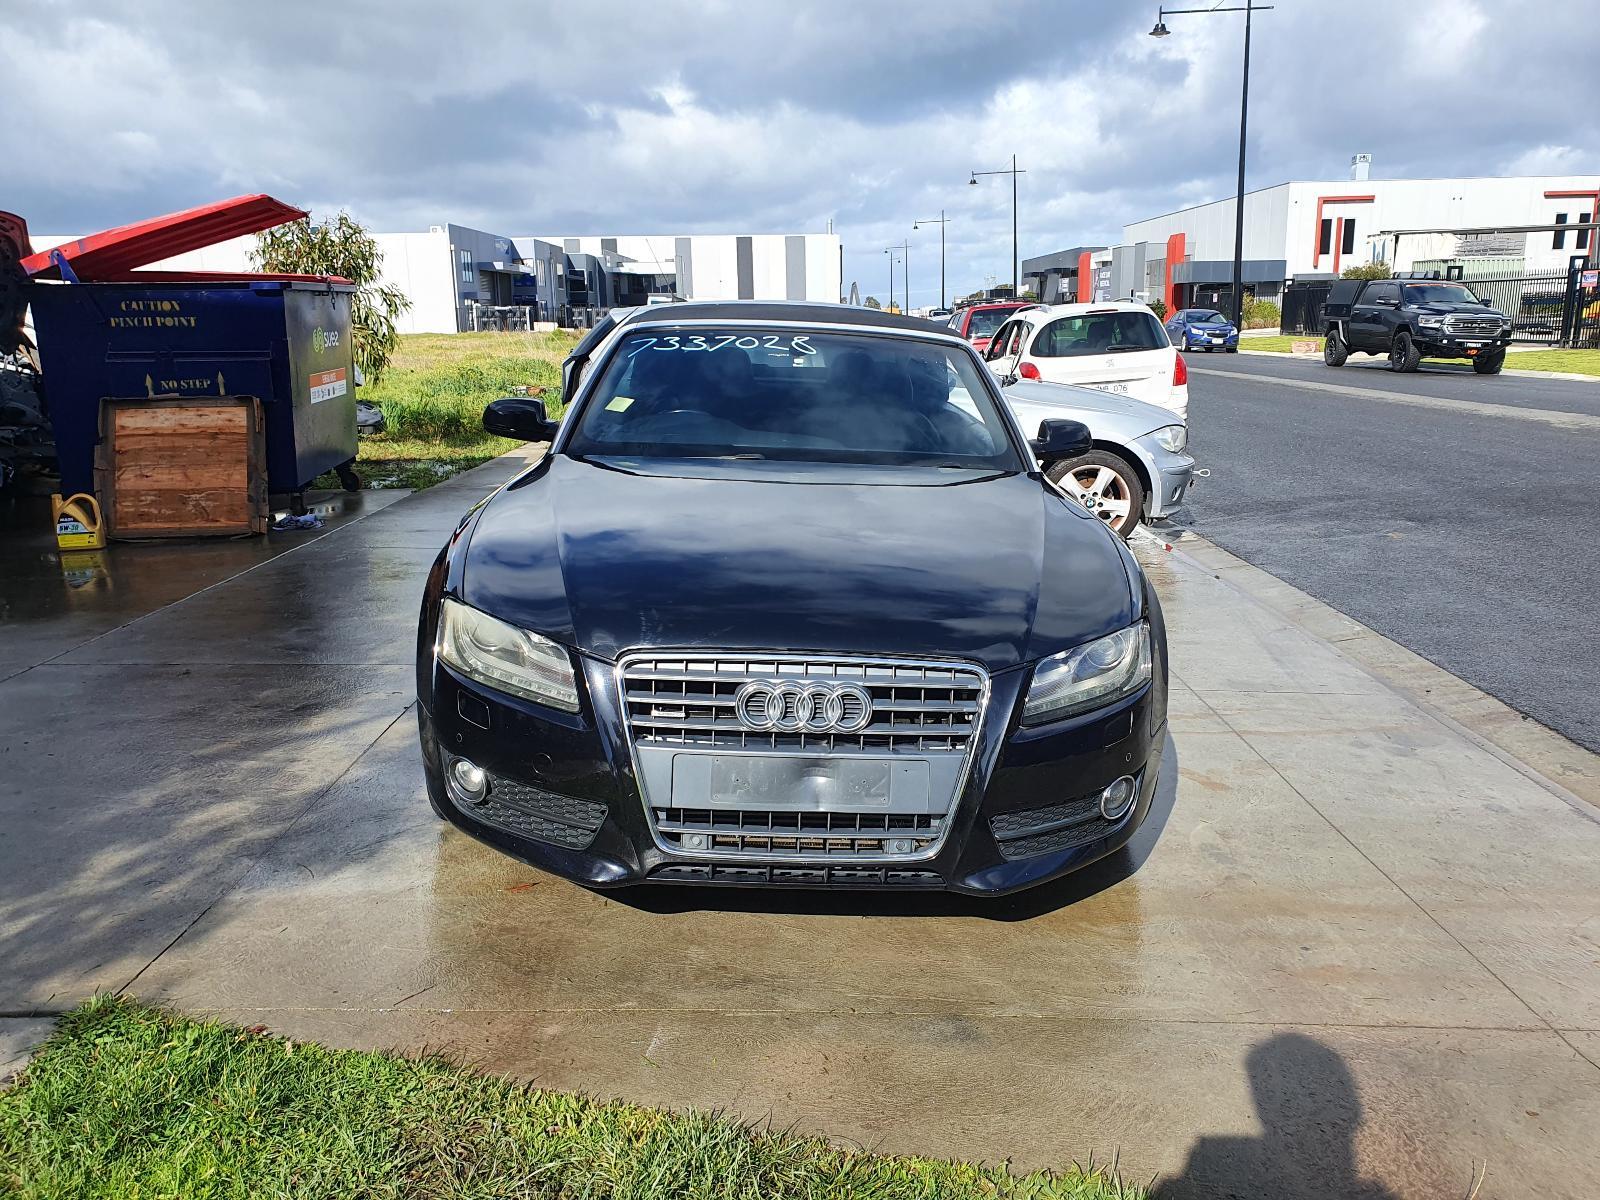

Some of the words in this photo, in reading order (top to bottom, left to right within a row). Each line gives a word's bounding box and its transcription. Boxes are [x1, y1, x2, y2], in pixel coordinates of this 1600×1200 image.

[121, 300, 180, 311] CAUTION
[110, 316, 152, 328] PINCH
[155, 316, 197, 328] POINT
[628, 335, 817, 358] 7337028
[160, 380, 178, 390] NO
[180, 378, 211, 389] STEP
